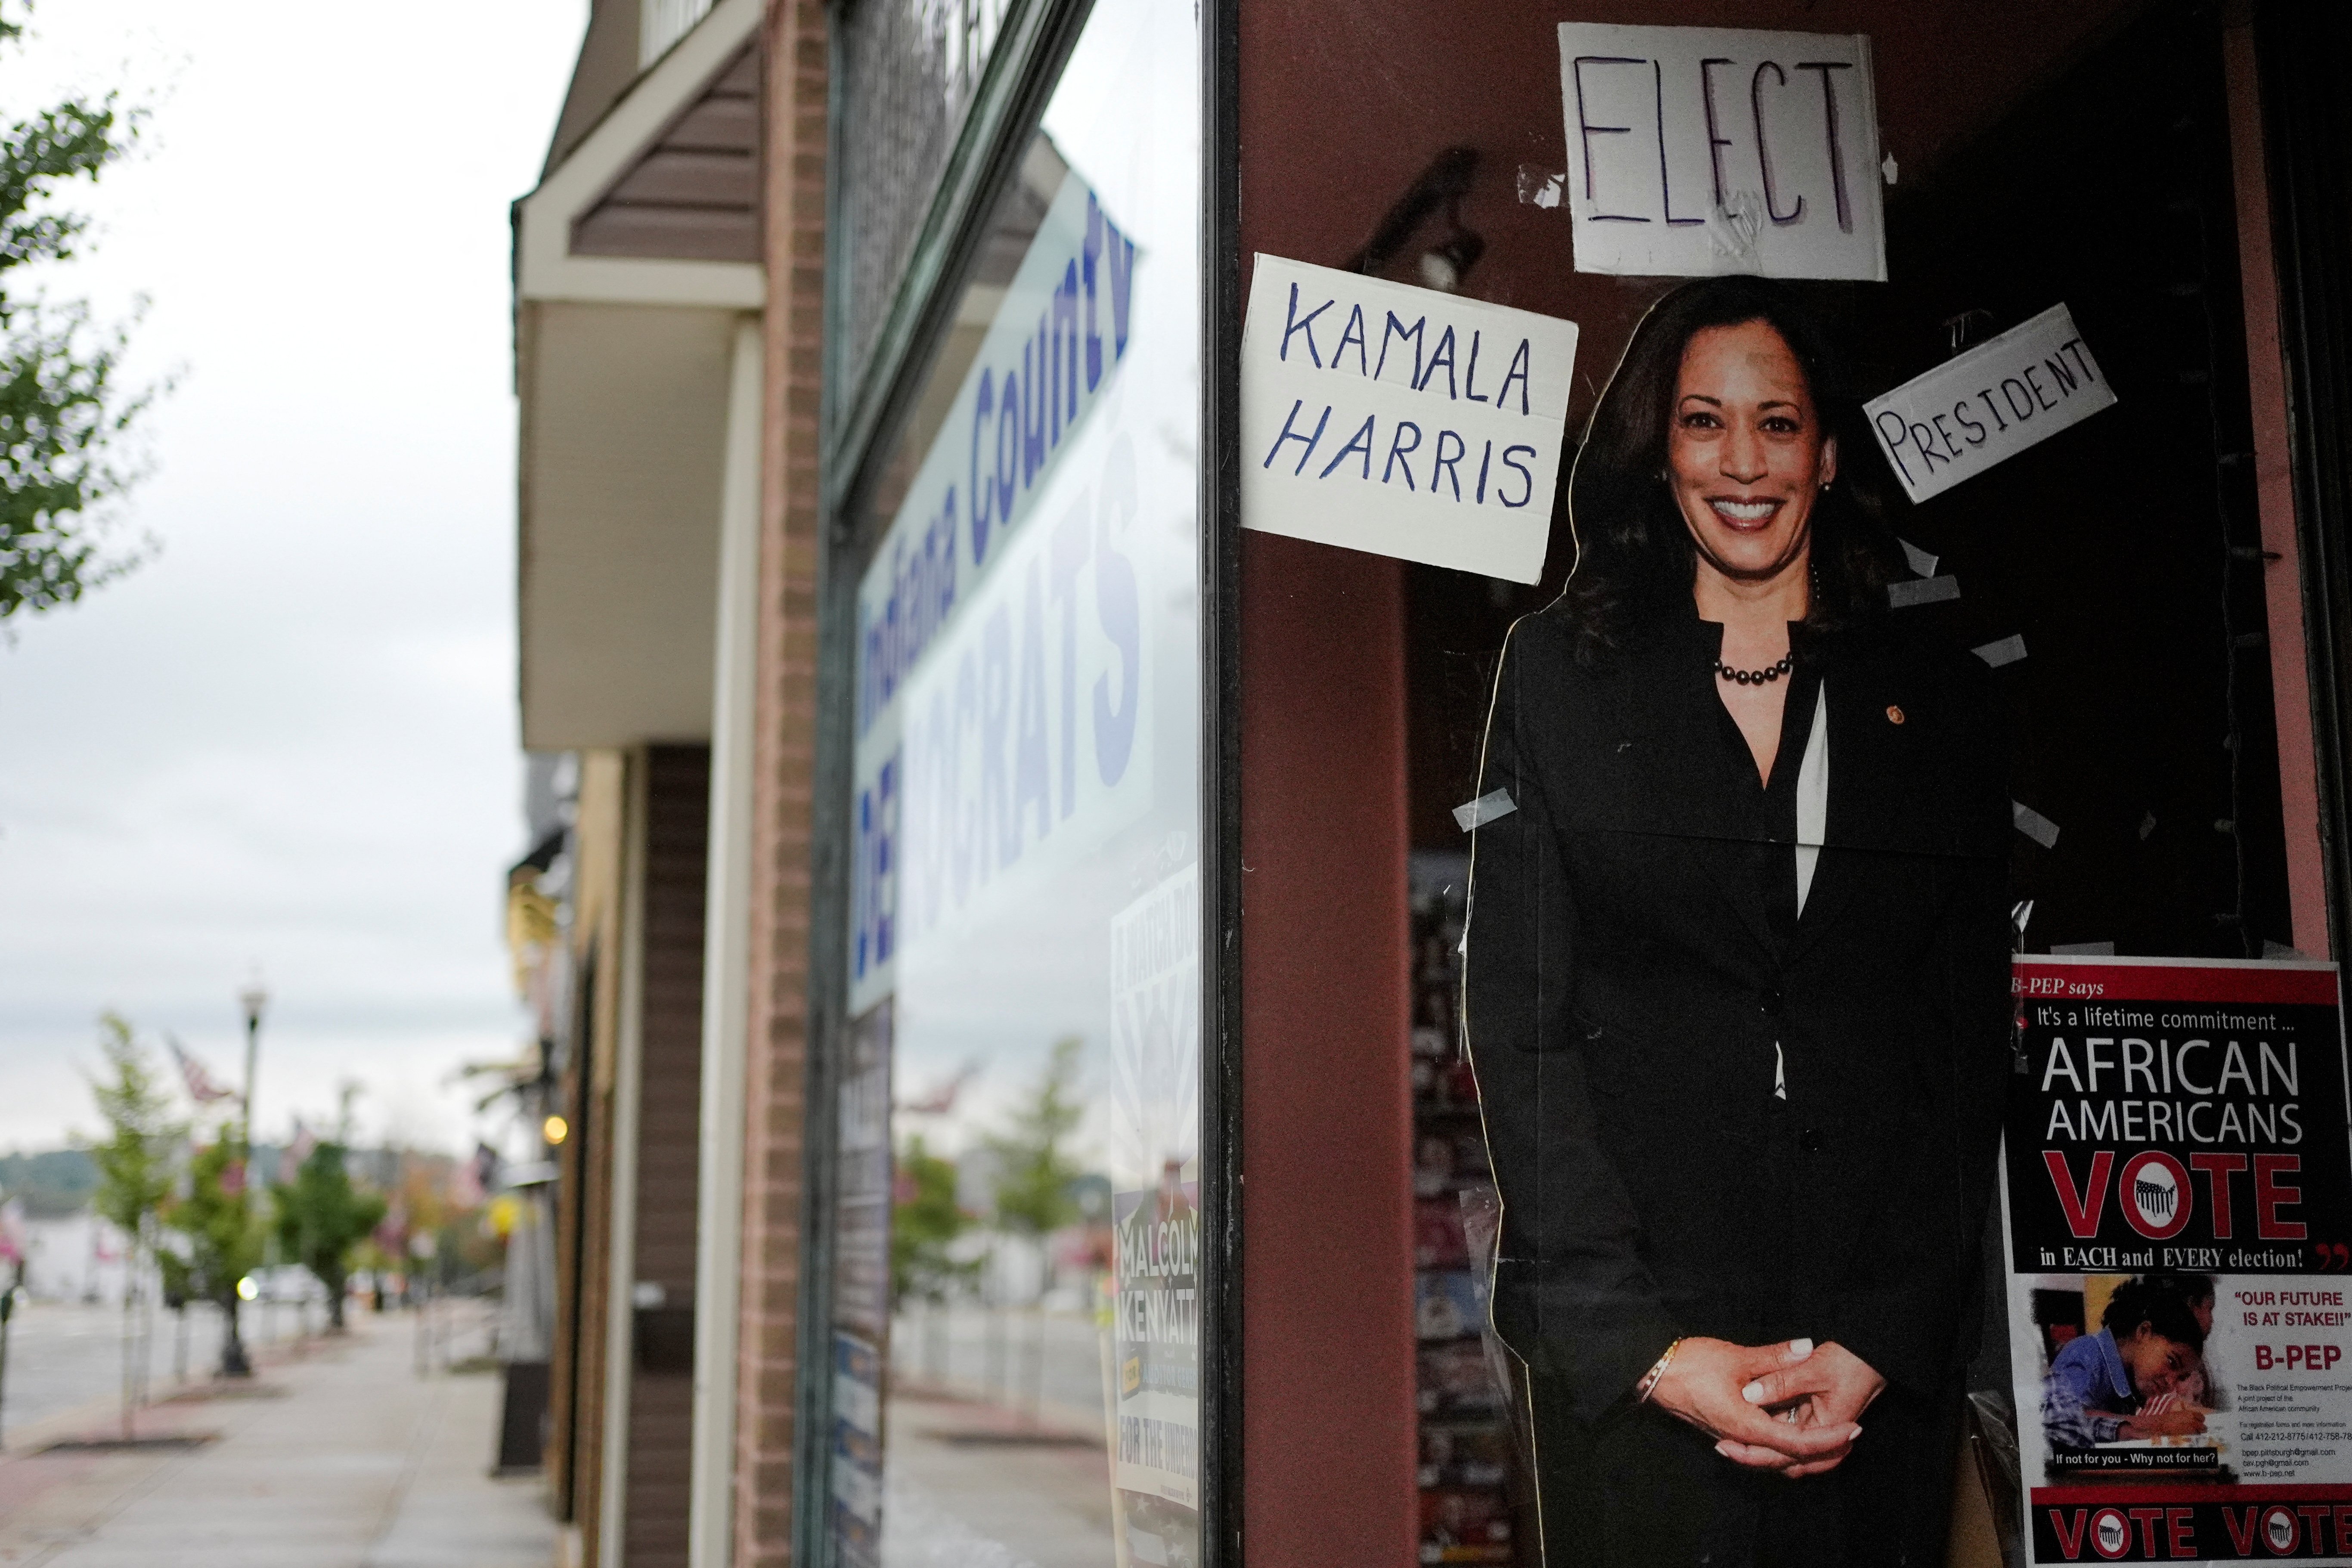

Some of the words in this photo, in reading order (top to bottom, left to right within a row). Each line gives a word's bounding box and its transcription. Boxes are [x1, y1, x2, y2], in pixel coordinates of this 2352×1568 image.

[1574, 56, 1853, 234] ELECT
[1280, 282, 1529, 416] KAMALA
[971, 188, 1134, 566] County
[1876, 338, 2094, 485] PRESIDENT
[1264, 400, 1536, 508] HARRIS
[856, 431, 1140, 979] DEOCRATS
[2011, 977, 2065, 994] B-PEP
[2068, 983, 2104, 999] says
[2038, 1006, 2061, 1026] It's
[2068, 1012, 2077, 1026] a
[2085, 1006, 2154, 1027] lifetime
[2161, 1011, 2276, 1030] commitment
[2042, 1037, 2299, 1096] AFRICAN
[2046, 1100, 2303, 1144] AMERICANS
[2042, 1150, 2307, 1240] VOTE
[2040, 1247, 2056, 1266] in
[2062, 1247, 2118, 1267] EACH
[2122, 1248, 2154, 1267] and
[2163, 1248, 2224, 1267] EVERY
[2229, 1248, 2303, 1267] election!
[2234, 1292, 2276, 1305] “OUR
[2280, 1292, 2343, 1306] FUTURE
[2243, 1312, 2258, 1326] IS
[2262, 1312, 2280, 1326] AT
[2255, 1345, 2341, 1370] B-PEP
[2335, 1384, 2352, 1392] Proje
[1119, 1415, 1140, 1464] FOR
[1143, 1418, 1163, 1469] THE
[2056, 1454, 2063, 1463] If
[2066, 1454, 2081, 1464] not
[2084, 1454, 2098, 1463] for
[2102, 1455, 2121, 1466] you
[2130, 1453, 2153, 1466] Why
[2157, 1453, 2173, 1463] not
[2176, 1453, 2191, 1463] for
[2194, 1453, 2215, 1463] her?
[2048, 1508, 2197, 1559] VOTE
